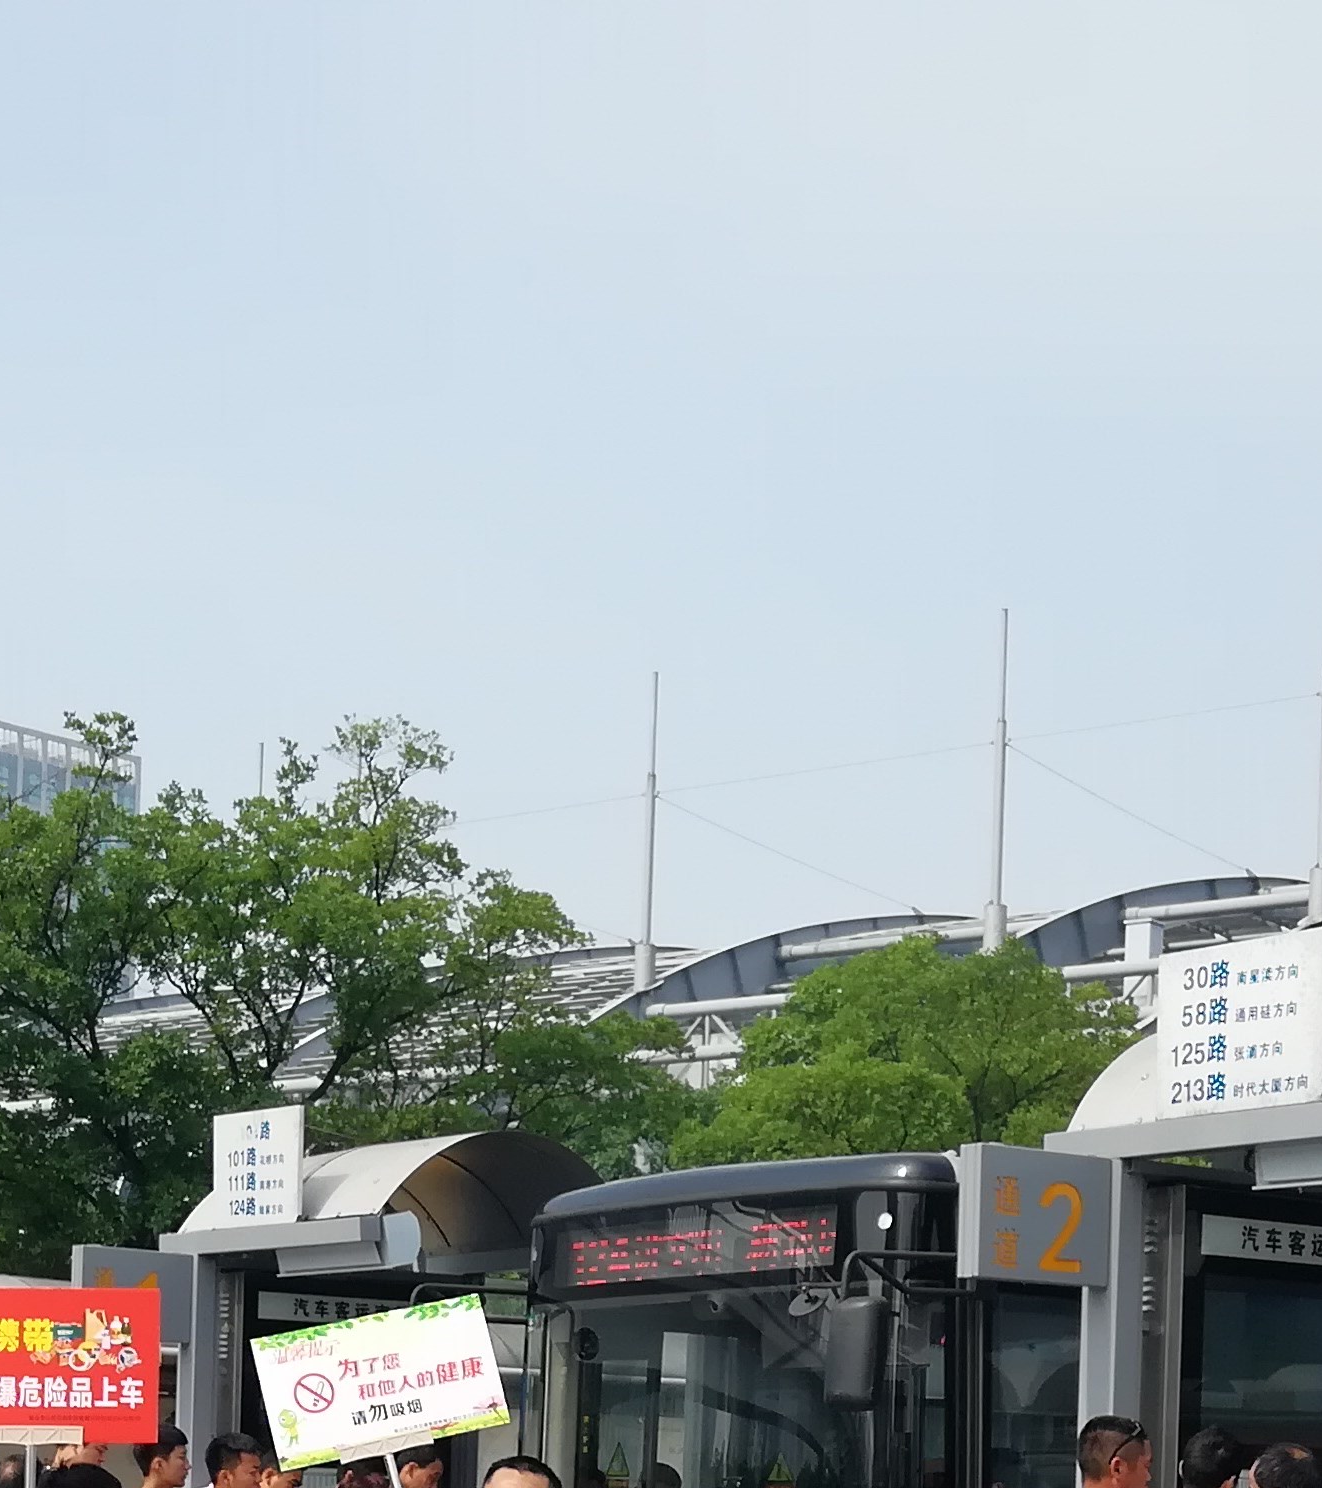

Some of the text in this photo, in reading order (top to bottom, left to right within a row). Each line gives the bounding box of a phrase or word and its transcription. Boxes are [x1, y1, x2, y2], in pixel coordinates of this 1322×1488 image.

[1183, 959, 1230, 991] 30路
[1181, 996, 1228, 1028] 58路
[1171, 1033, 1227, 1068] 125路
[1171, 1072, 1309, 1105] 213路 时代大厦方向
[228, 1147, 257, 1168] 101路
[228, 1171, 257, 1192] 111路
[229, 1196, 257, 1216] 124路
[994, 1175, 1082, 1273] 通道 2
[338, 1353, 401, 1381] 为了您
[358, 1356, 485, 1400] 和他人的健康
[351, 1399, 423, 1426] 请勿吸烟
